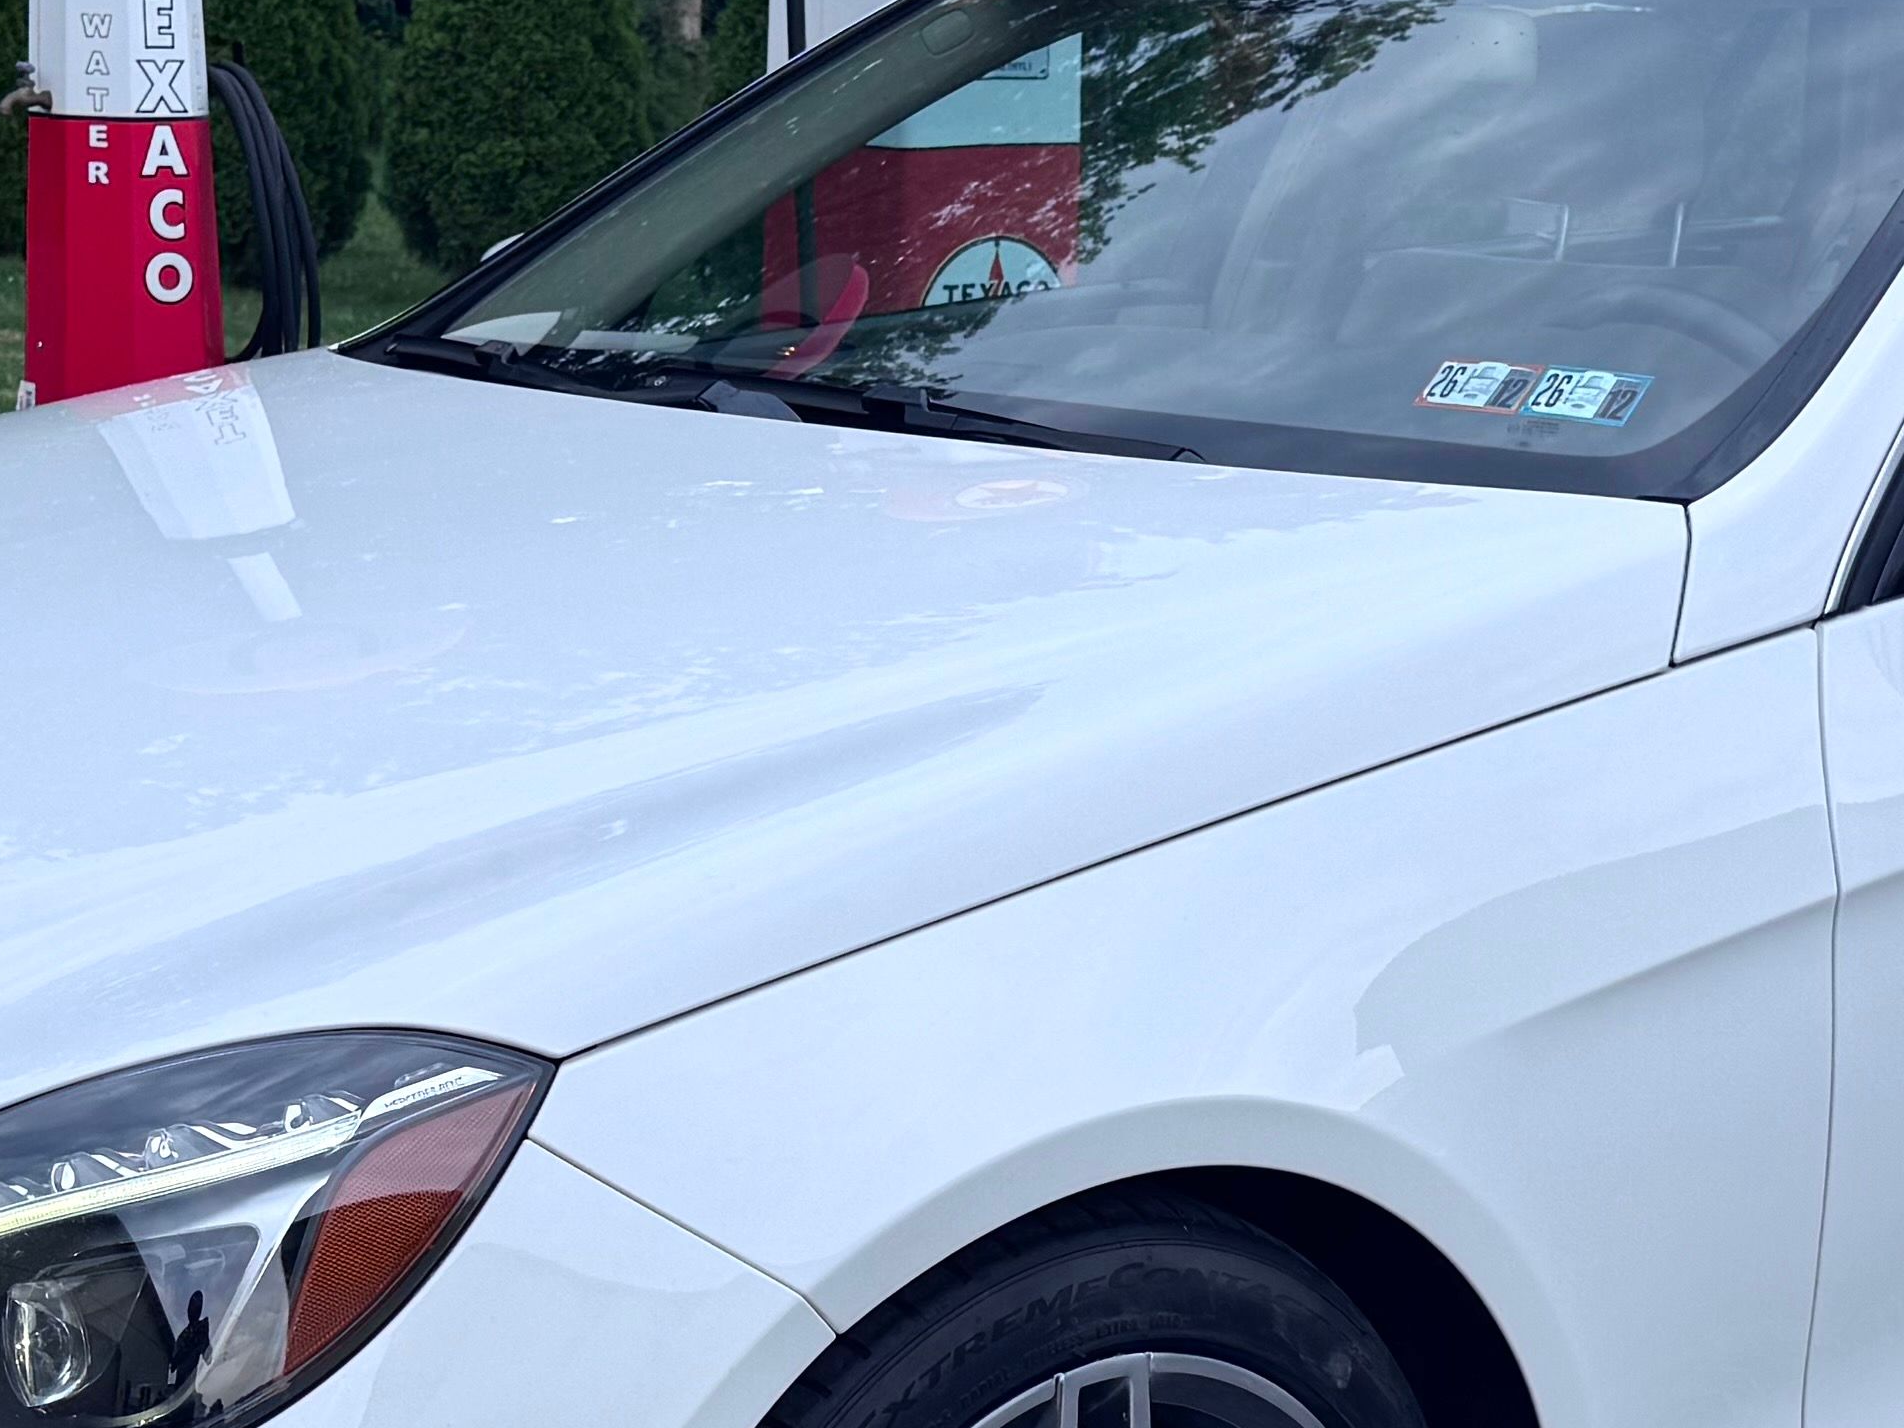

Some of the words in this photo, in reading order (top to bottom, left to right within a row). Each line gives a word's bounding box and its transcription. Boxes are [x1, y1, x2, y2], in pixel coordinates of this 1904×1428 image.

[81, 12, 113, 185] WATER
[1427, 364, 1467, 398] 26
[1490, 377, 1530, 409] 12
[1530, 373, 1573, 407] 26
[1599, 388, 1638, 421] 12
